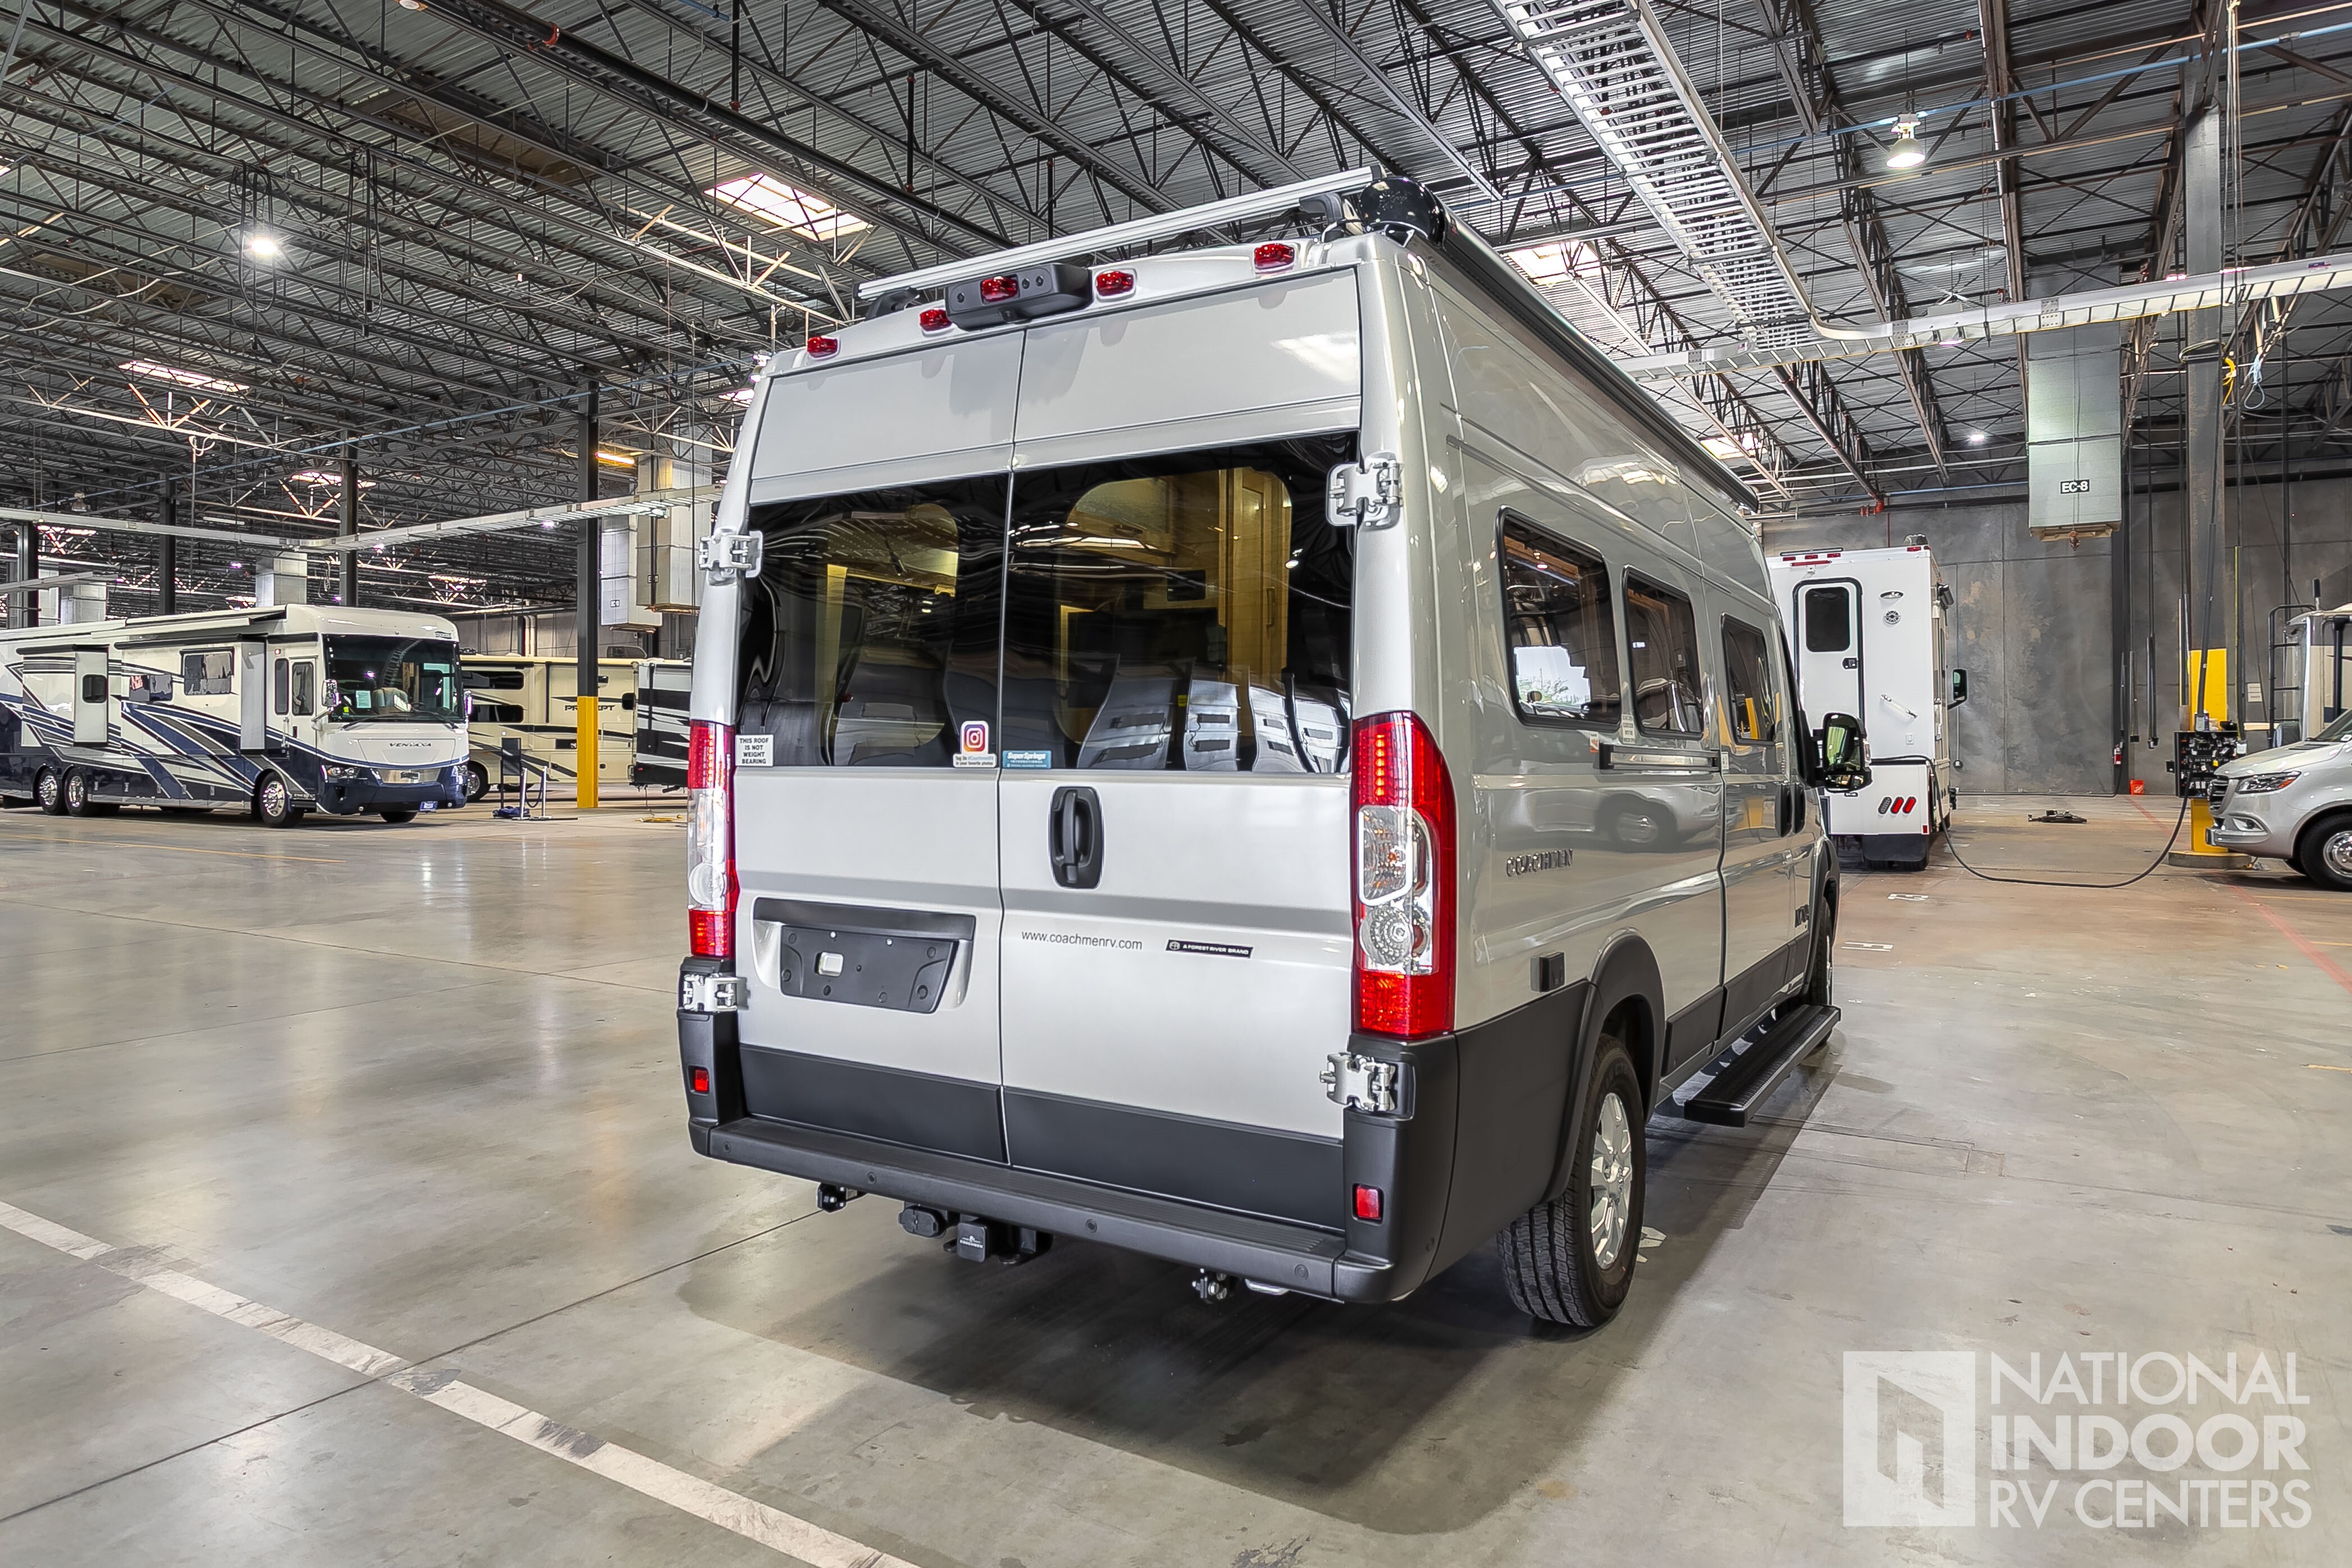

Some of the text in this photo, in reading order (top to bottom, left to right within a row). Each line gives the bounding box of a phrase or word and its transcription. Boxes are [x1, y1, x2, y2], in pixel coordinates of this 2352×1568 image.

[2062, 481, 2088, 492] EC-8
[1506, 848, 1573, 877] COACHMEN
[1021, 931, 1143, 950] www.coachmenrv.com
